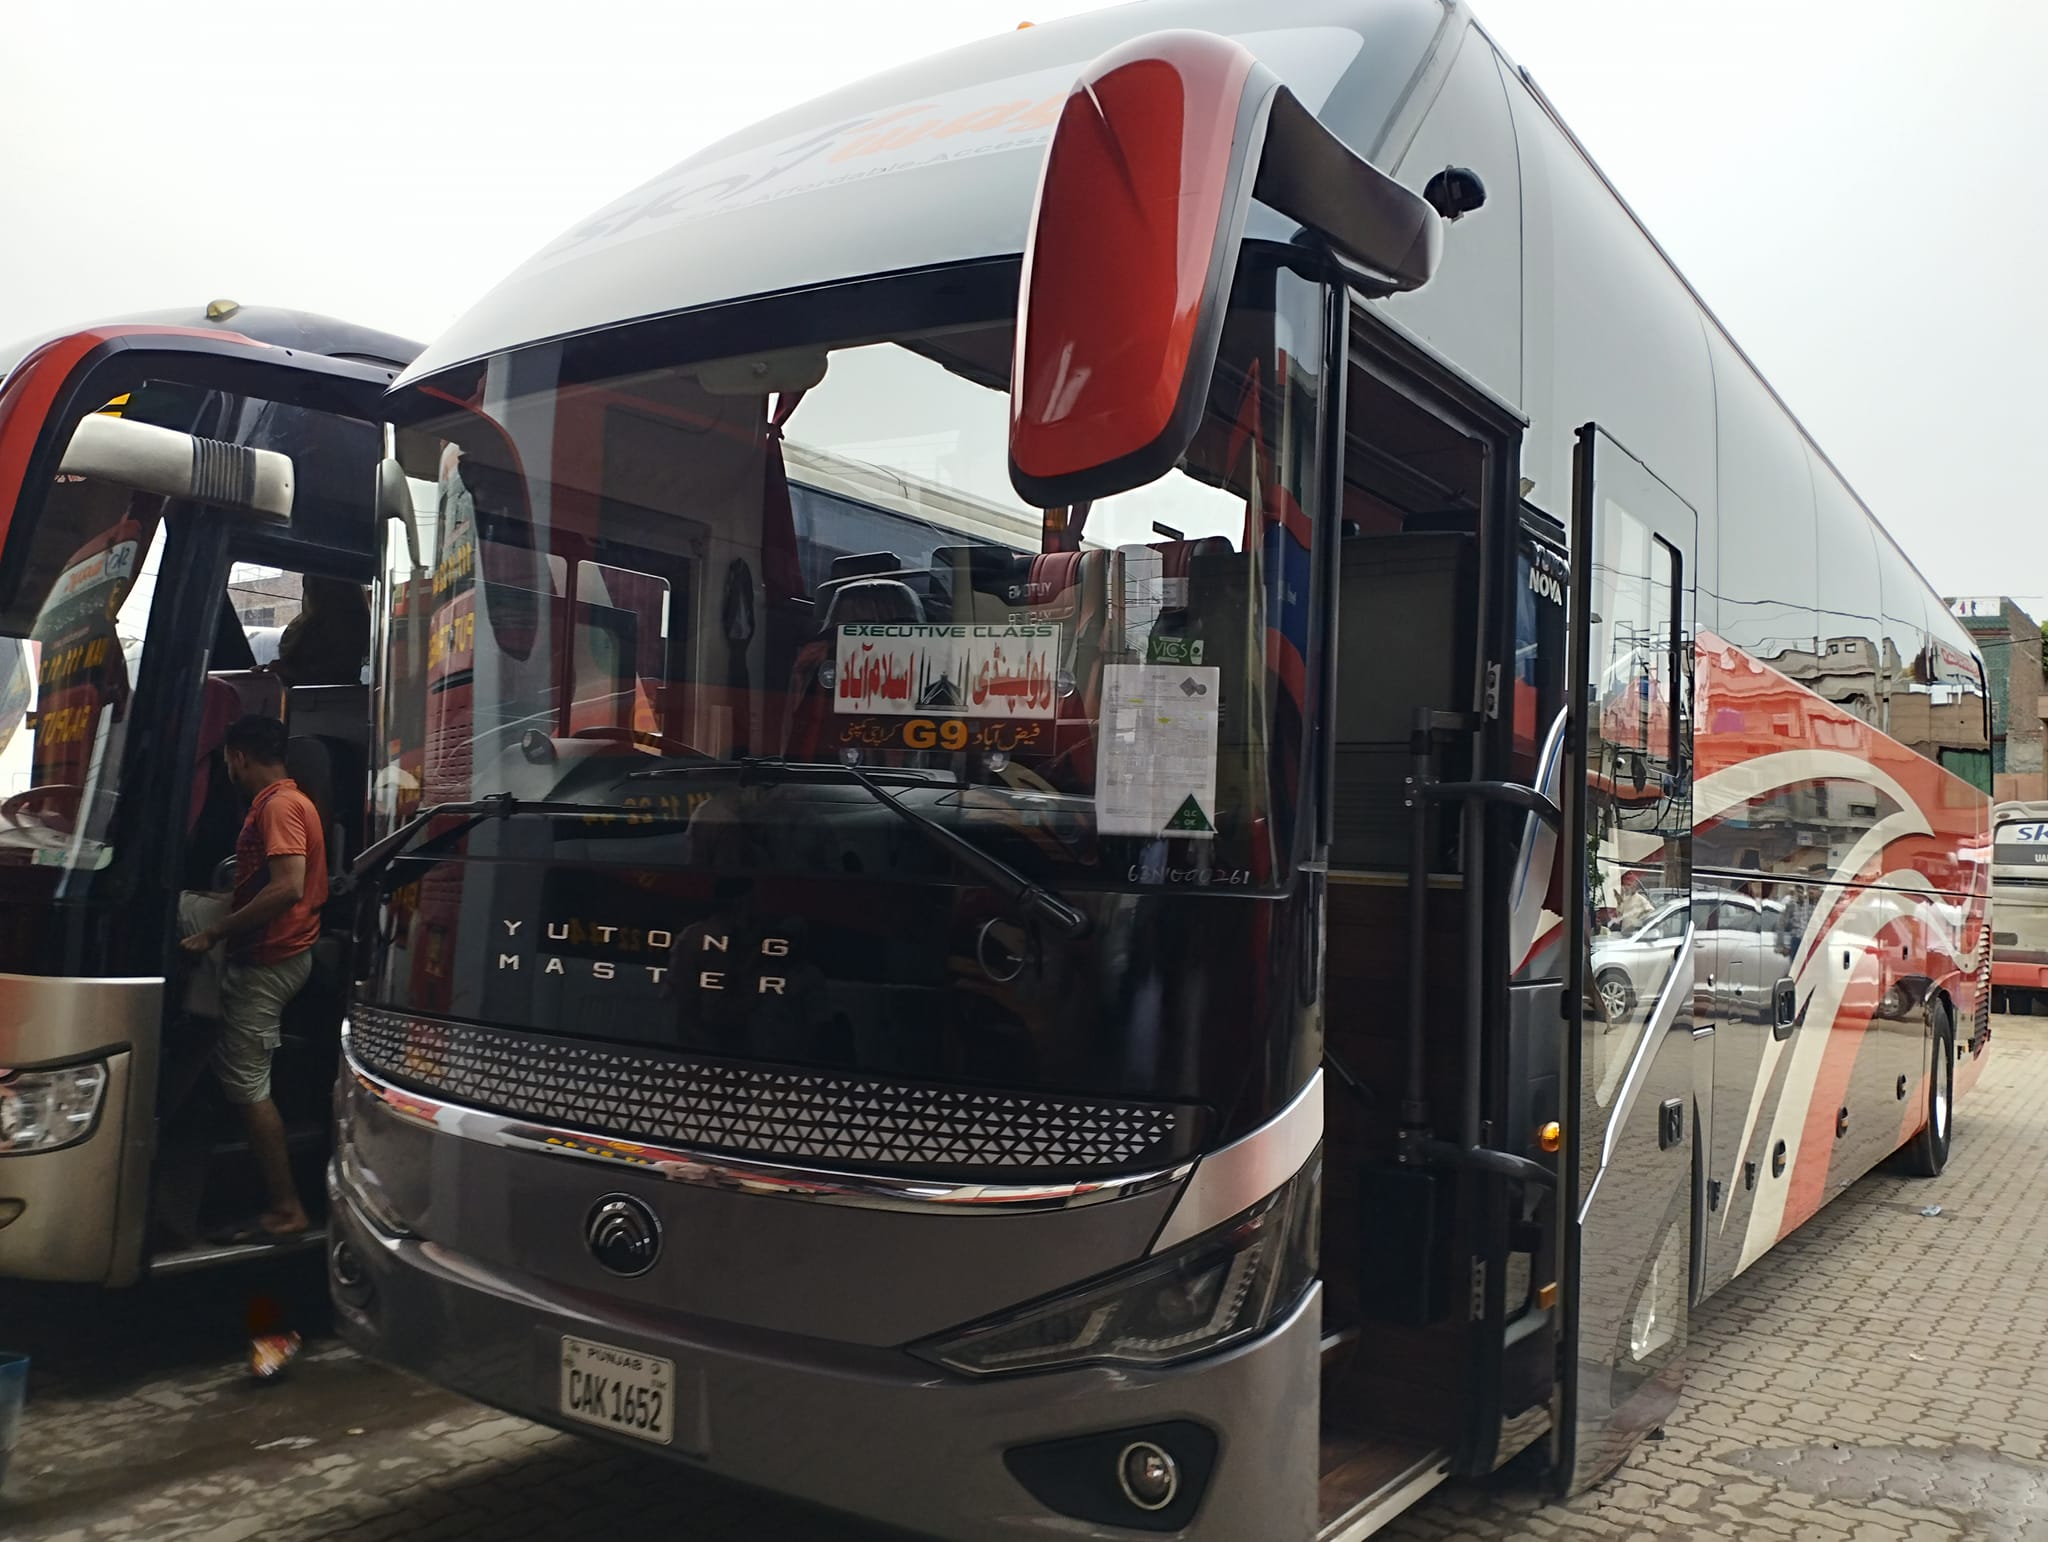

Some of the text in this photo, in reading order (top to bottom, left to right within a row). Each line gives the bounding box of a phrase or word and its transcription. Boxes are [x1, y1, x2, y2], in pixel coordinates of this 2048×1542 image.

[1529, 567, 1562, 606] NOVA
[843, 625, 1053, 638] EXECUTIVE CLASS
[1152, 640, 1188, 658] VICS
[972, 642, 1051, 714] راولپنڈی
[903, 719, 968, 750] G9
[503, 919, 790, 957] YUTONG
[499, 953, 787, 995] MASTER
[587, 1347, 643, 1371] PUNJAB
